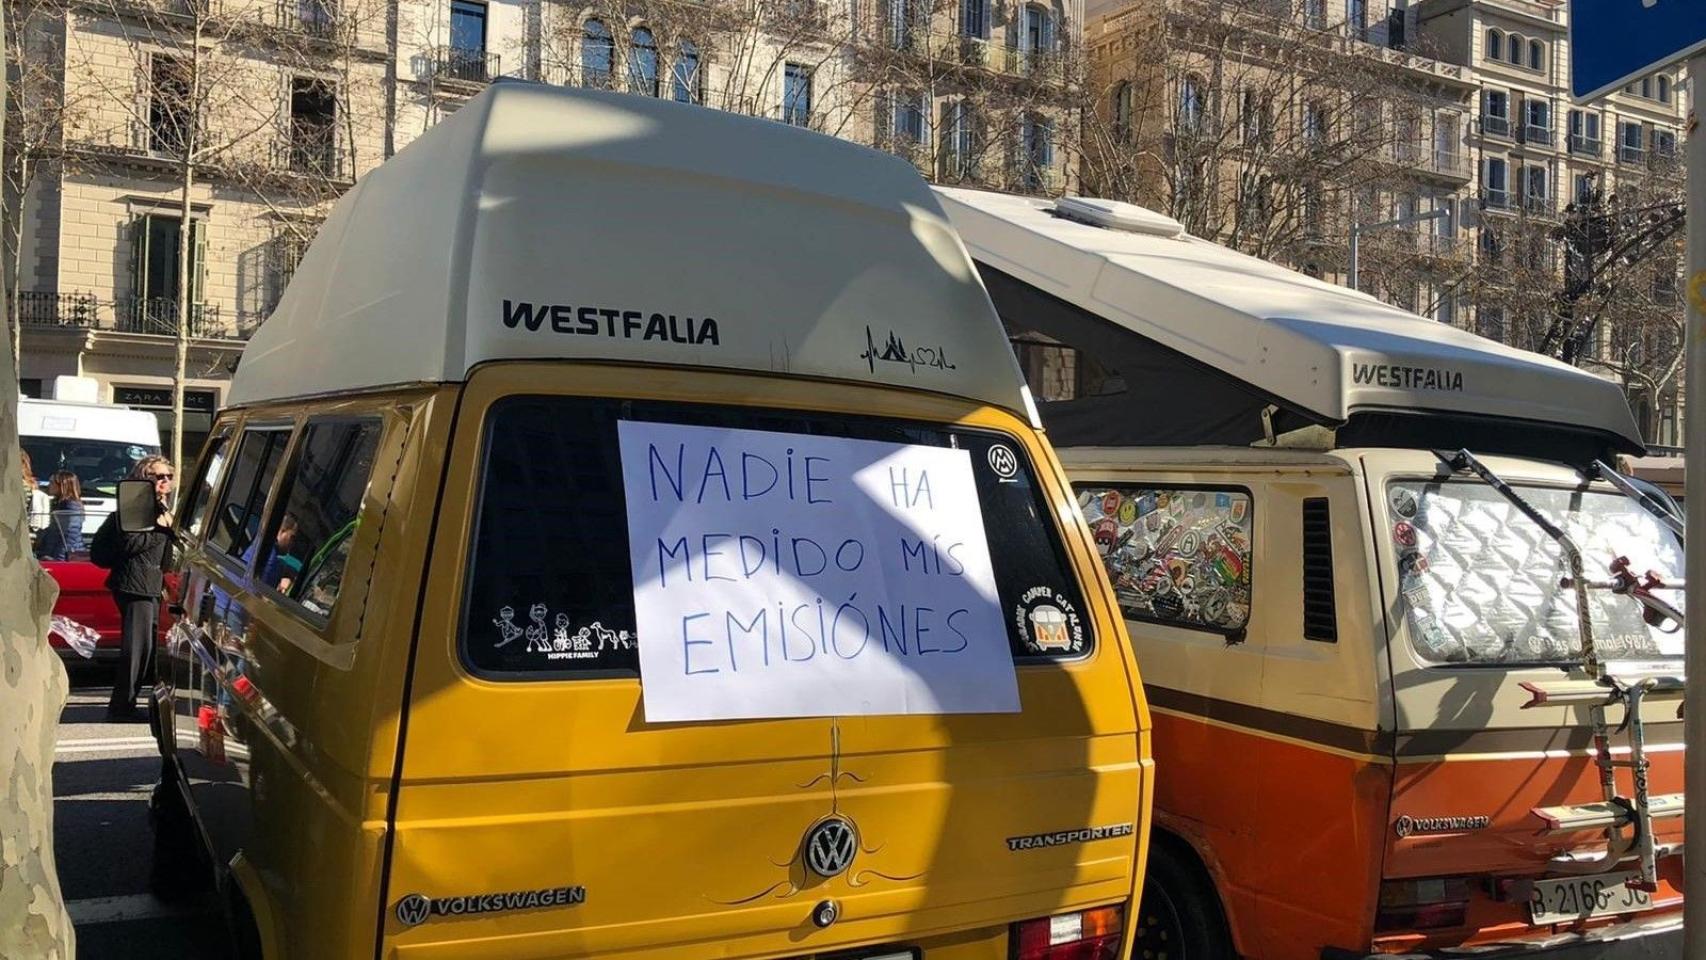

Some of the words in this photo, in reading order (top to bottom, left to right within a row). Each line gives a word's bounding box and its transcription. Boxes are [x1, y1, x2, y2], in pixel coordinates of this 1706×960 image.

[502, 299, 720, 346] WESTFALIA
[1352, 364, 1464, 391] WESTFALIA
[125, 393, 162, 401] ZARA
[888, 466, 934, 510] HA
[547, 652, 573, 660] HIPPIE
[573, 651, 600, 659] FAMILY
[1415, 815, 1489, 831] VOLKSWAGEN
[1008, 824, 1133, 850] TRANSPORTER
[437, 886, 584, 915] VOLKSWAGEN
